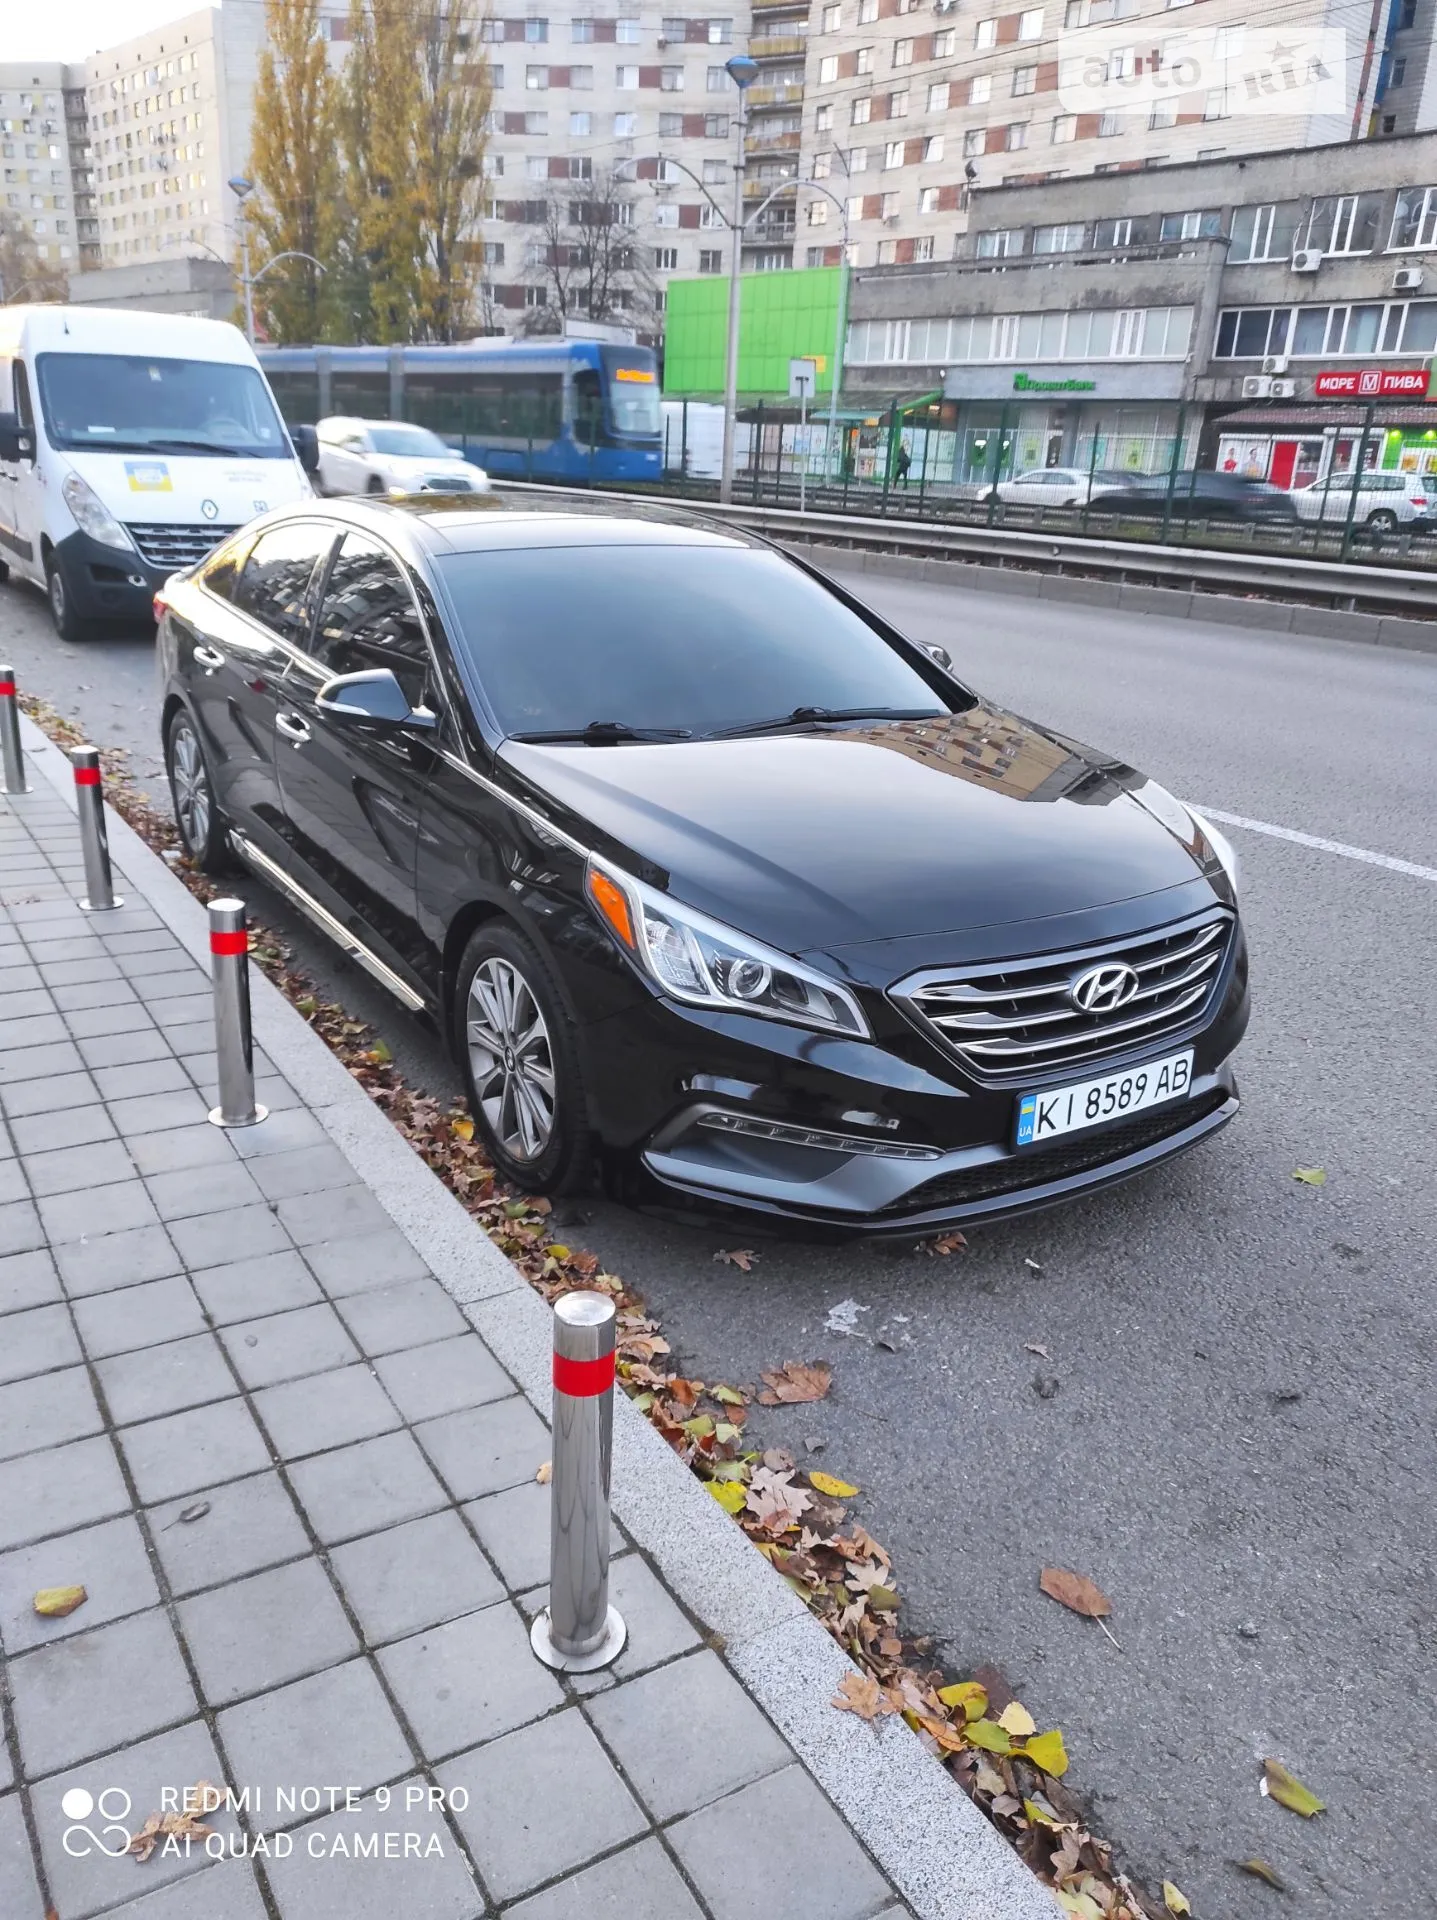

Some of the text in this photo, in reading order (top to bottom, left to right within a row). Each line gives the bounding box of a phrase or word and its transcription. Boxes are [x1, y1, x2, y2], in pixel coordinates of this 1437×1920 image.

[1319, 377, 1356, 390] МОРЕ
[1383, 375, 1424, 389] ПИВА
[1037, 1058, 1189, 1134] KI 8589 AB
[1019, 1126, 1032, 1138] UA
